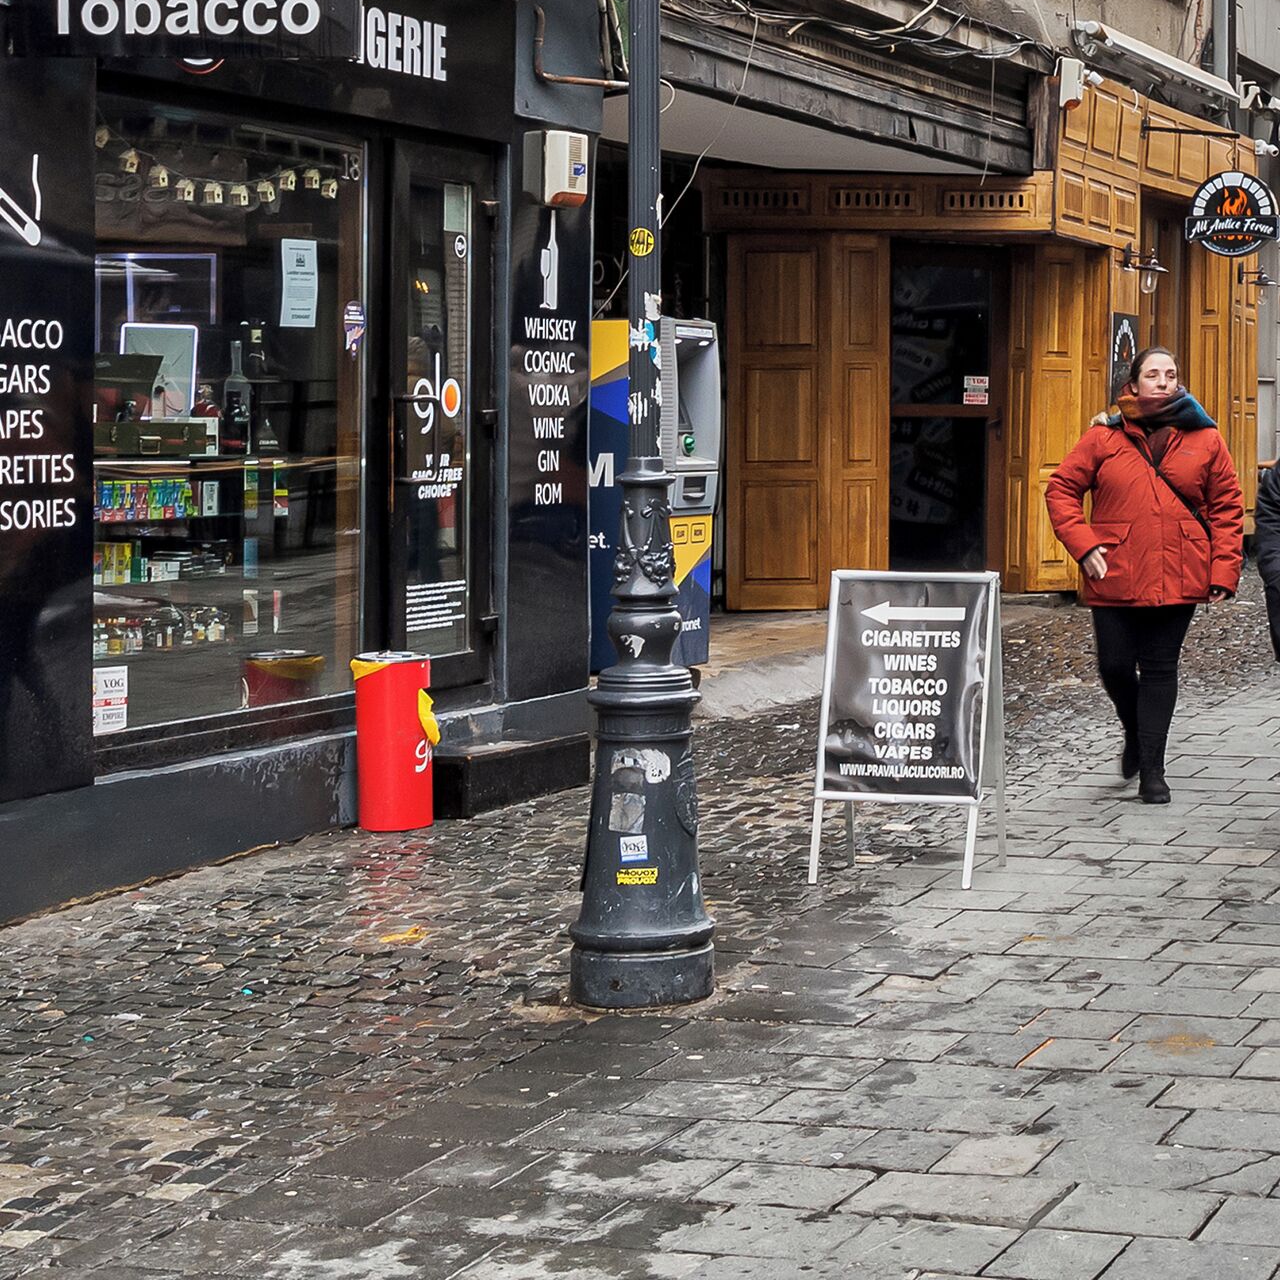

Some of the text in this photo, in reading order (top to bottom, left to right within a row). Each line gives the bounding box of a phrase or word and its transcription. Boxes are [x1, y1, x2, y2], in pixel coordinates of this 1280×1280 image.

[341, 153, 362, 181] 18
[0, 318, 63, 350] ACCO
[524, 316, 577, 342] WHISKEY
[524, 350, 576, 375] COGNAC
[413, 352, 462, 435] glo
[528, 384, 571, 408] VODKA
[533, 417, 565, 440] WINE
[537, 449, 560, 472] GIN
[535, 483, 562, 505] ROM
[861, 629, 961, 648] CIGARETTES
[884, 653, 937, 671] WINES
[868, 676, 948, 696] TOBACCO
[872, 698, 941, 716] LIQUORS
[873, 721, 936, 741] CIGARS
[873, 745, 933, 760] VAPES
[839, 762, 965, 780] WWW.PRAVALIACULICORI.RO
